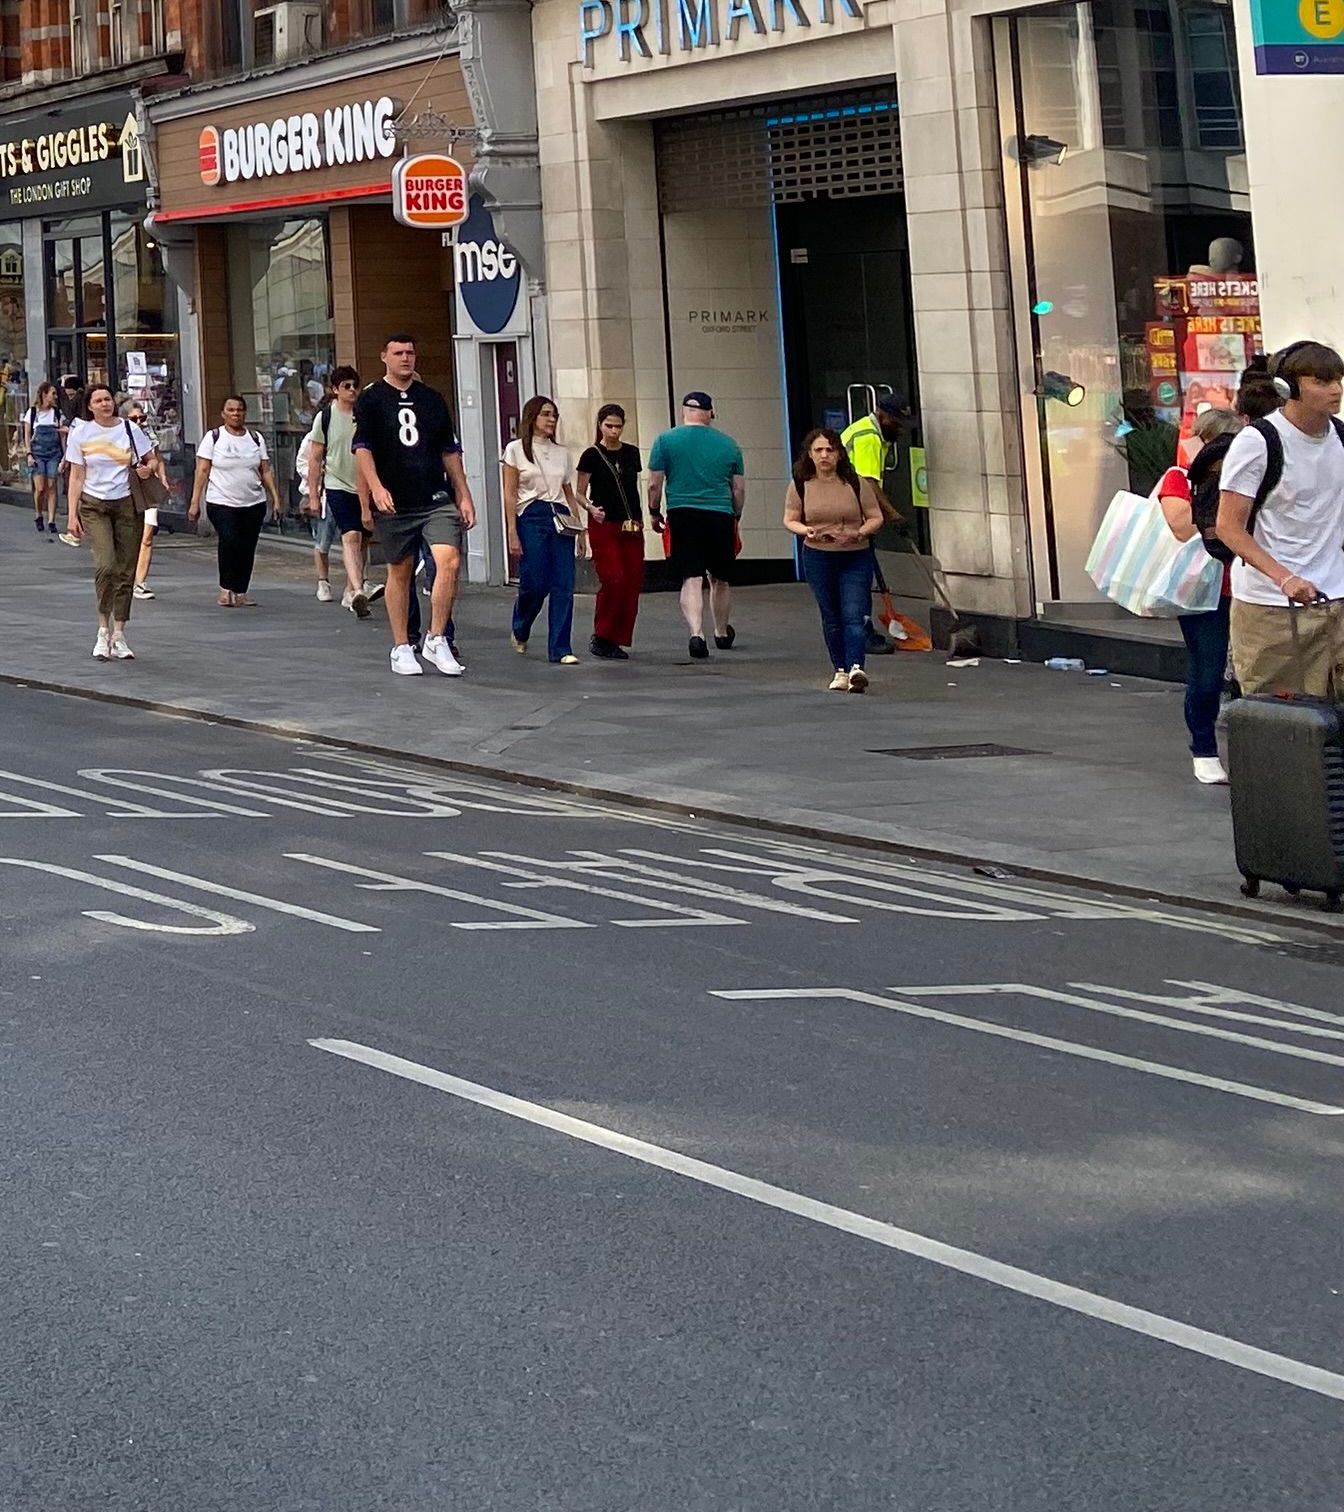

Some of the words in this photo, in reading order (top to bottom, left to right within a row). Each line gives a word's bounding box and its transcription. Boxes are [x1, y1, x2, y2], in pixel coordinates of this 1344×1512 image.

[21, 139, 34, 174] &
[37, 122, 109, 171] GIGGLES
[223, 112, 322, 182] BURGER
[324, 96, 396, 166] KING
[10, 187, 22, 205] THE
[23, 183, 54, 204] LONDON
[55, 180, 70, 200] GIFT
[71, 176, 92, 196] SHOP
[405, 178, 463, 192] BURGER
[406, 192, 464, 212] KING
[688, 310, 769, 323] PRIMARK
[732, 325, 757, 333] STREET
[397, 407, 419, 448] 8
